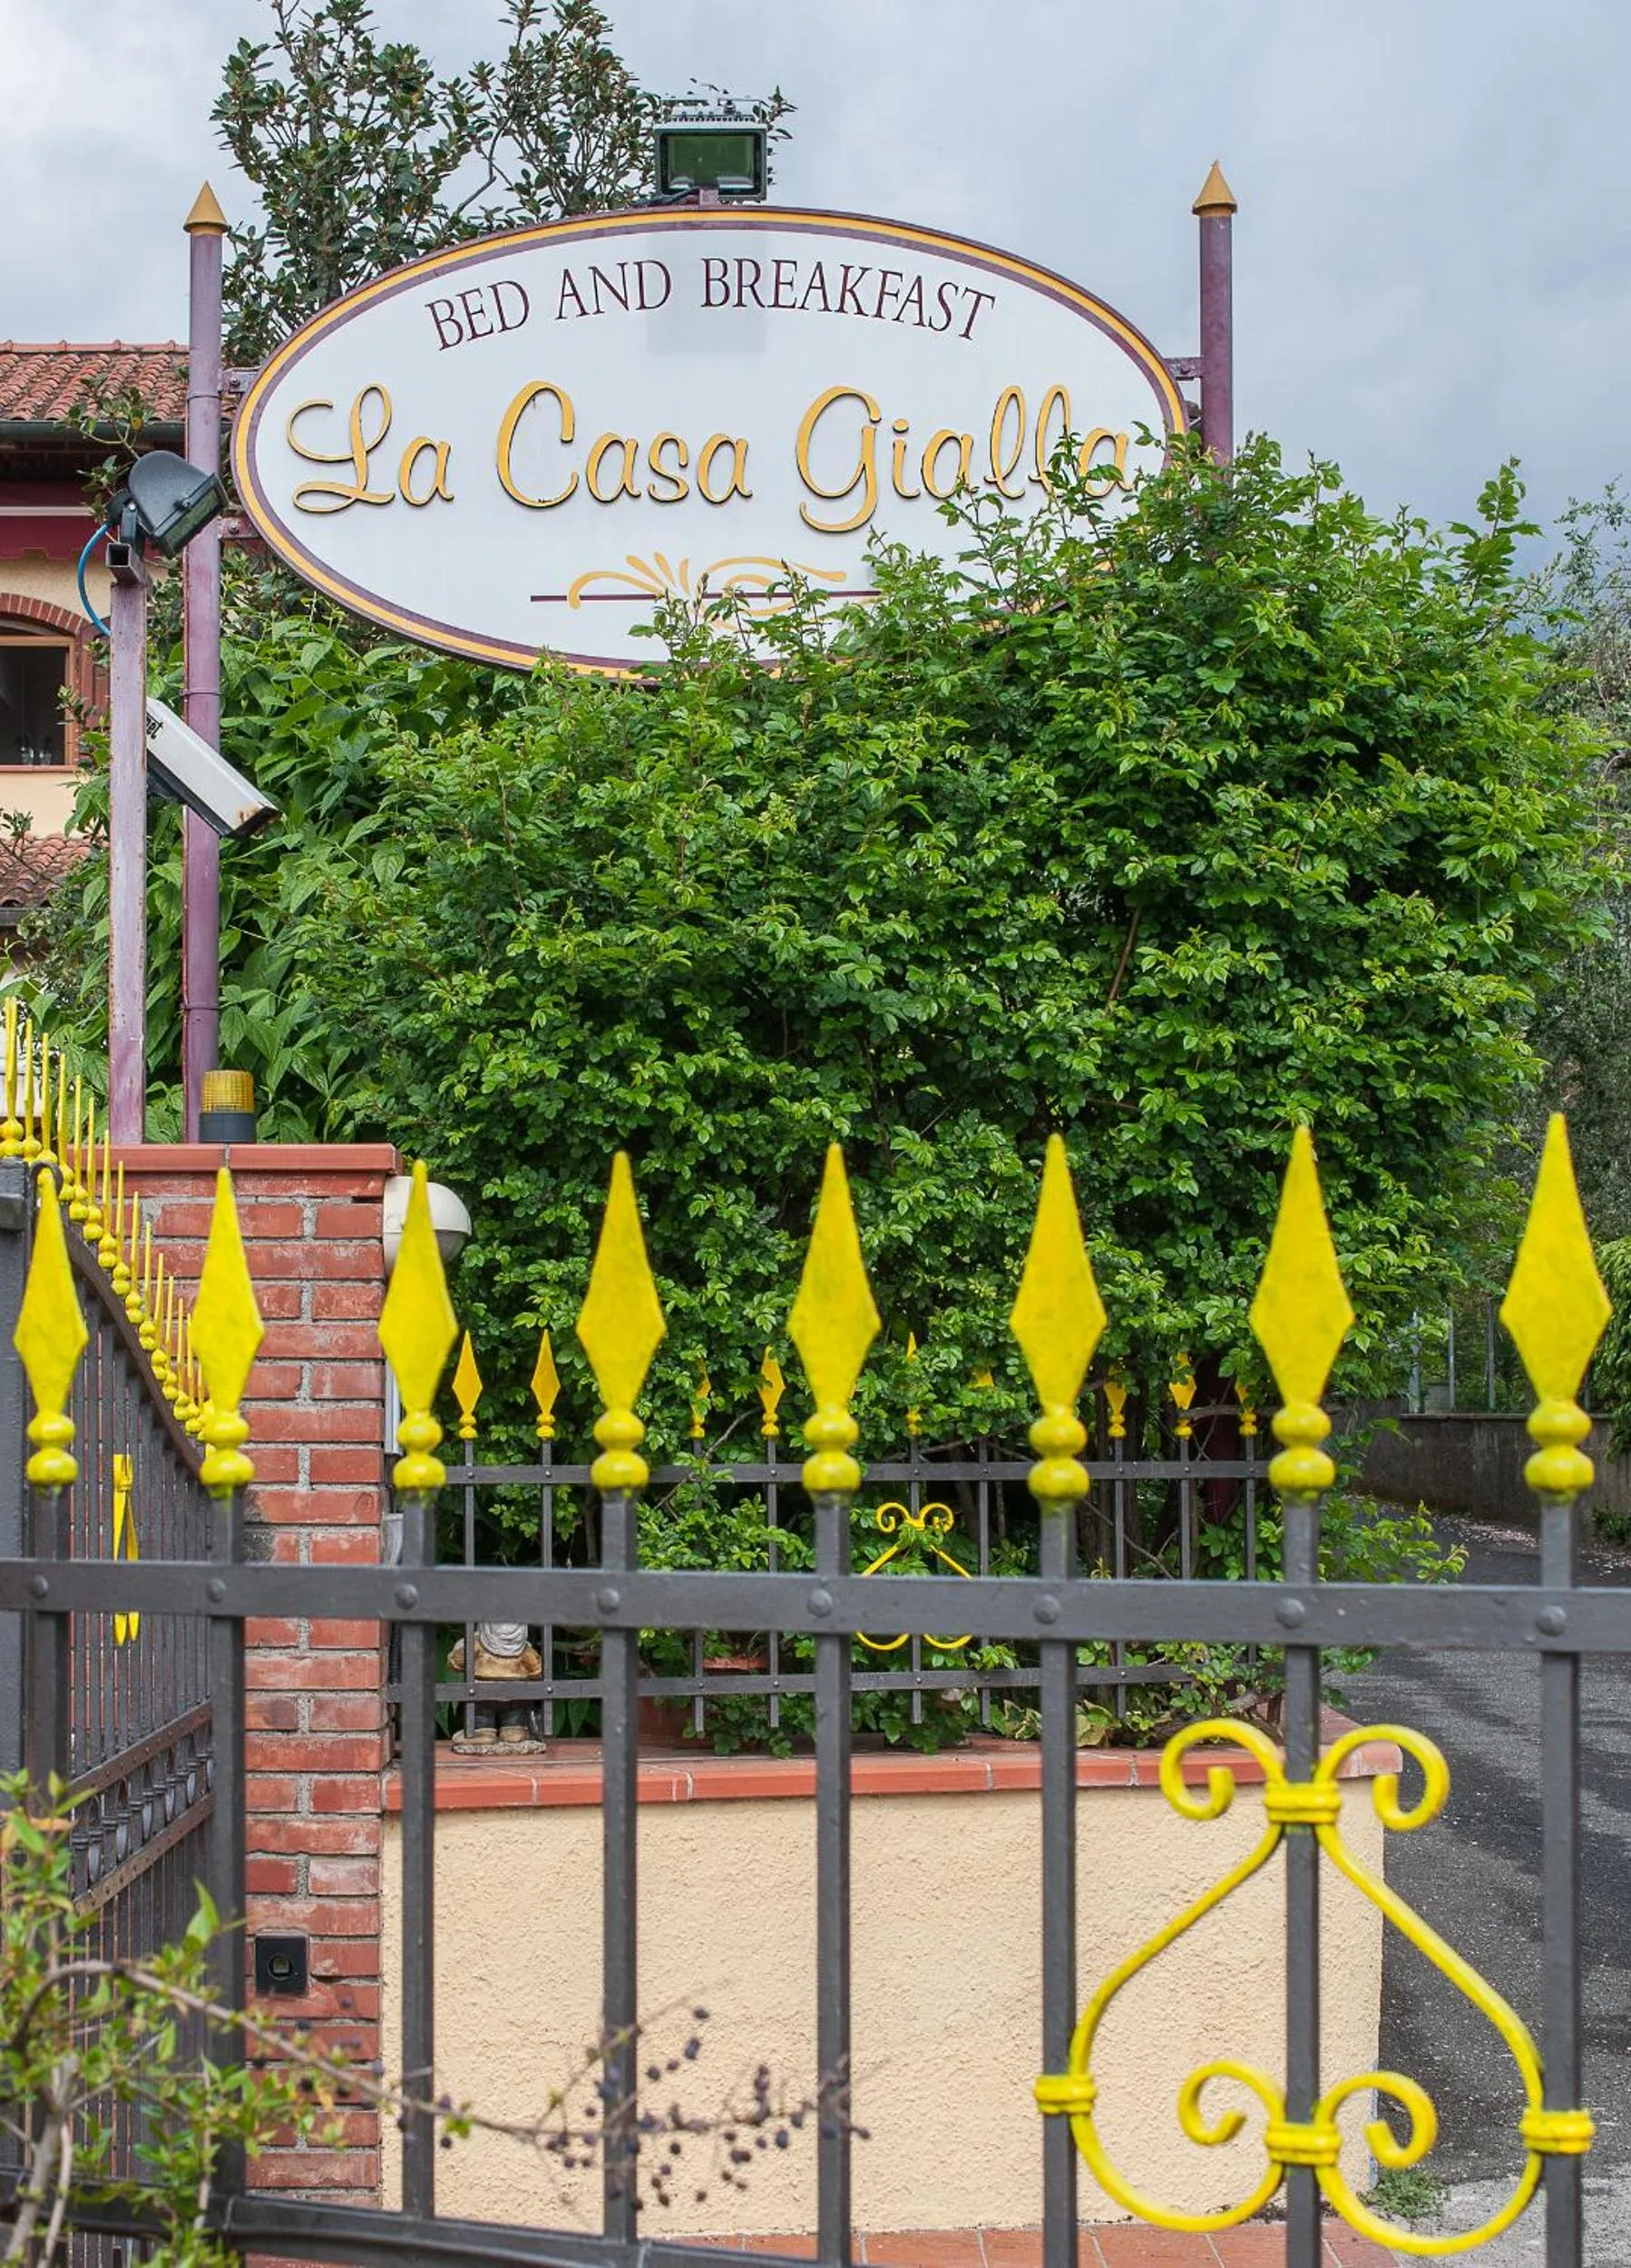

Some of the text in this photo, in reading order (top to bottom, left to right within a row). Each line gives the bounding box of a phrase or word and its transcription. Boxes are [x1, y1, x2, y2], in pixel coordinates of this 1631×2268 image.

[425, 258, 996, 352] BED AND BREAKFAST
[287, 379, 1133, 533] La Casa Gialla
